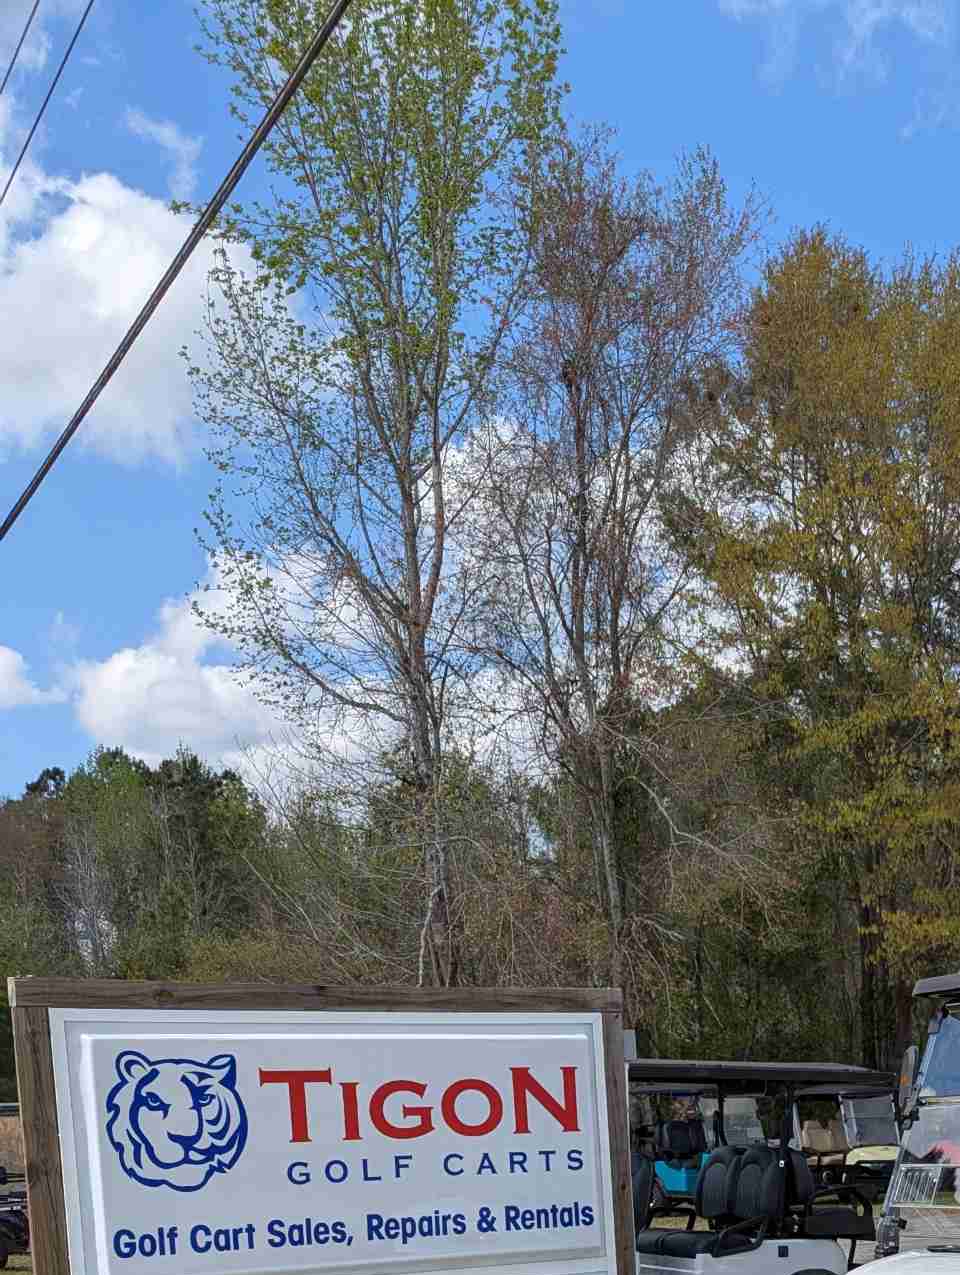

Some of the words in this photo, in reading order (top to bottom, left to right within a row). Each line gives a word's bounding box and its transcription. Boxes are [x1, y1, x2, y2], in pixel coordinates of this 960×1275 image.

[257, 1066, 580, 1143] TIGON
[287, 1155, 413, 1185] GOLF
[443, 1150, 585, 1176] CARTS
[113, 1226, 178, 1259] Golf
[189, 1223, 256, 1254] Cart
[267, 1219, 353, 1248] Sales,
[366, 1209, 467, 1244] Repairs
[476, 1206, 497, 1233] &
[504, 1201, 595, 1232] Rentals
